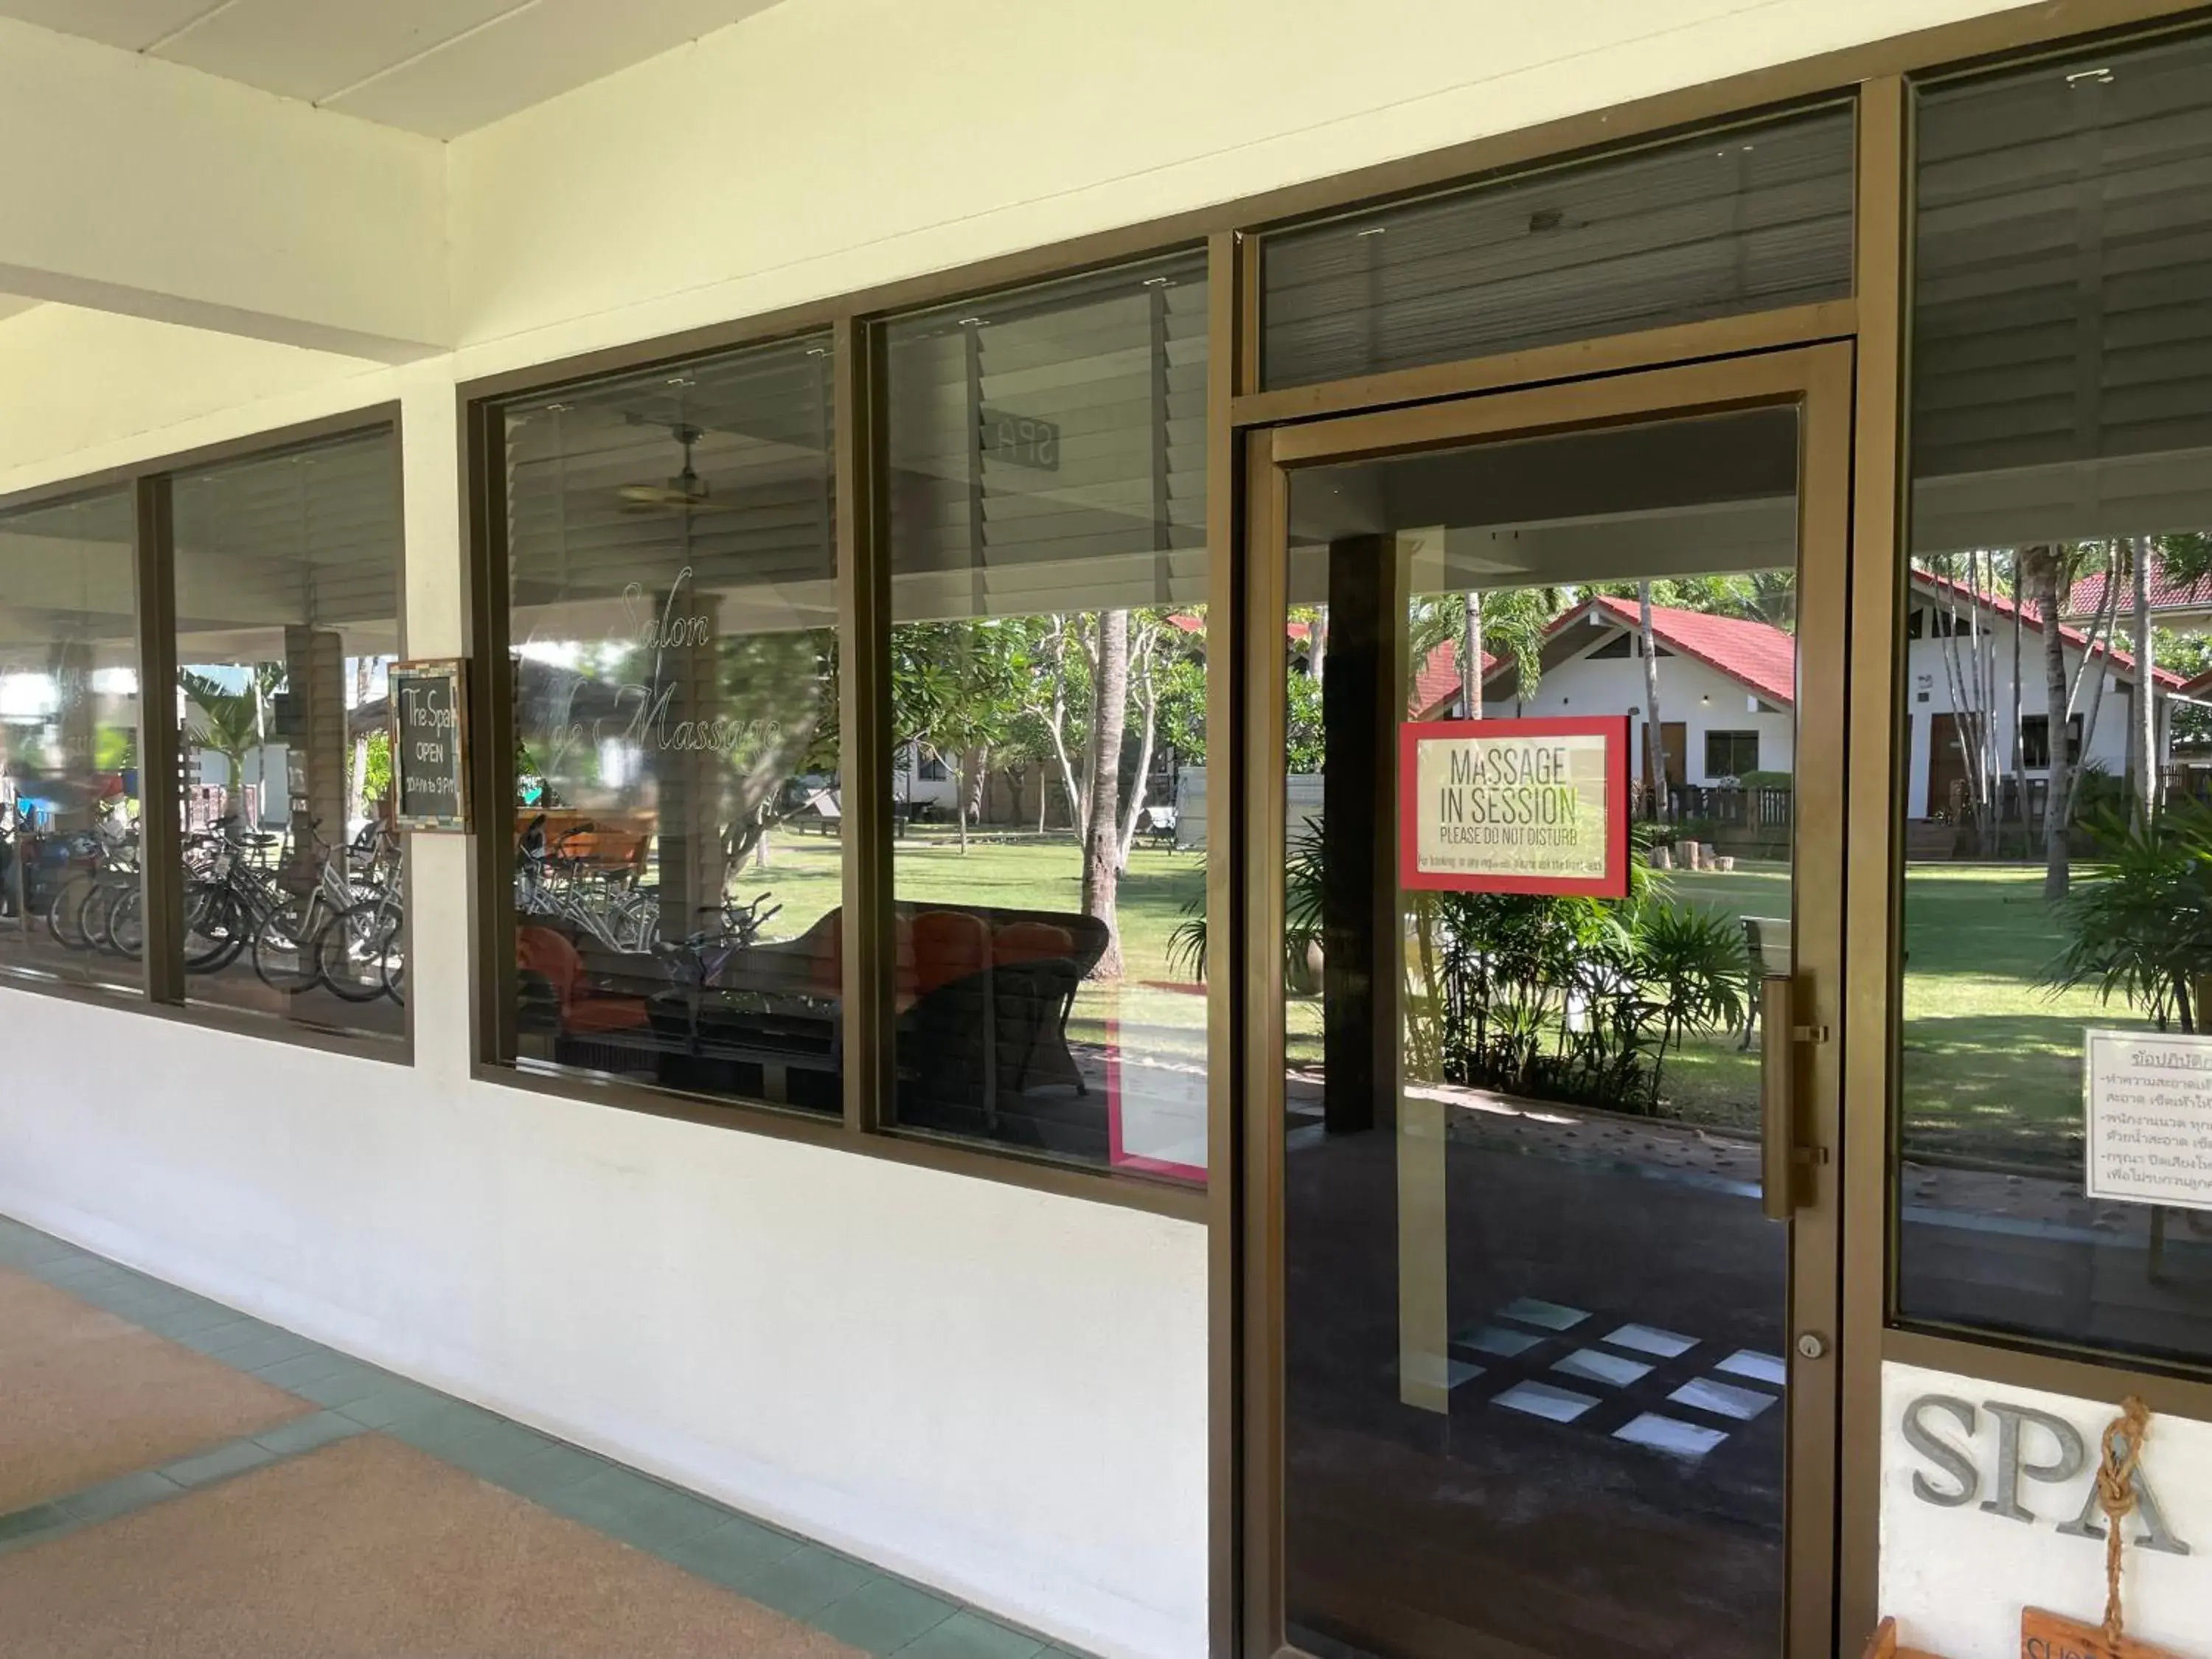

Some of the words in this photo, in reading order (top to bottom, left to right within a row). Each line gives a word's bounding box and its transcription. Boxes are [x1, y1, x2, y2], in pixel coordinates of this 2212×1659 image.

[402, 688, 427, 727] The
[428, 689, 451, 738] Spa
[416, 741, 444, 763] OPEN
[1450, 747, 1567, 785] MASSAGE
[1441, 788, 1464, 824] IN
[1472, 787, 1577, 826] SESSION
[1440, 826, 1481, 844] PLEASE
[1484, 827, 1499, 844] DO
[1503, 827, 1524, 845] NOT
[1527, 828, 1578, 846] DISTURB
[1900, 1394, 2192, 1556] SPA
